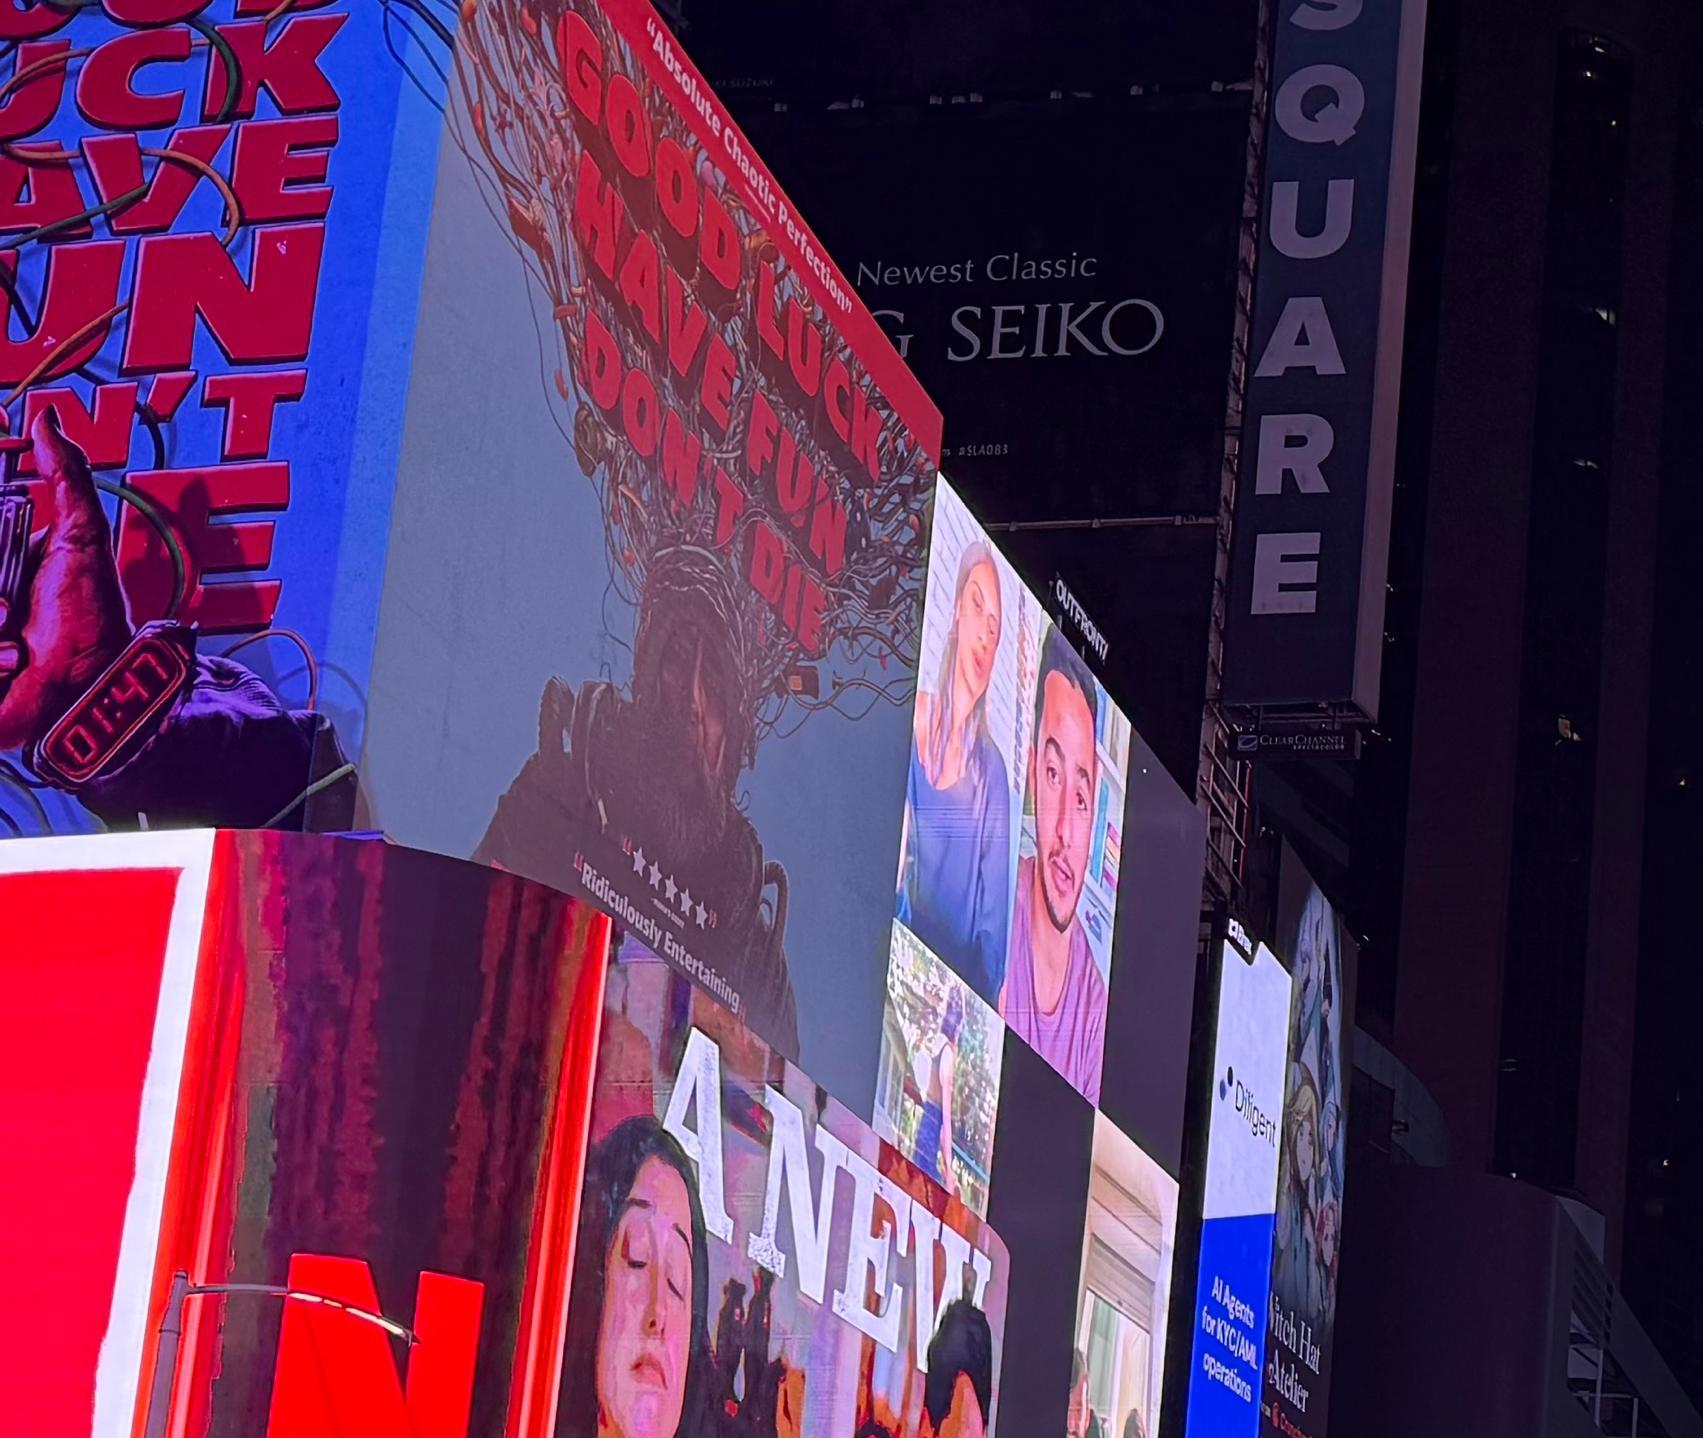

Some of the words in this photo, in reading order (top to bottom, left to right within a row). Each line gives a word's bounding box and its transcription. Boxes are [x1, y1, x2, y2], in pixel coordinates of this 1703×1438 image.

[723, 128, 776, 215] Chaotic
[557, 10, 741, 291] GOOD
[757, 261, 884, 483] LUCK
[856, 258, 974, 288] Newest
[986, 251, 1098, 283] Classic
[574, 150, 737, 432] HAVE
[747, 387, 848, 576] FUN
[946, 298, 1166, 363] SEIKO
[749, 519, 827, 653] DIE
[662, 1026, 735, 1246] A
[1235, 1081, 1276, 1149] Diligent
[1211, 1275, 1222, 1301] AI
[1223, 1281, 1255, 1330] Agents
[1202, 1309, 1217, 1338] for
[1217, 1318, 1258, 1370] KYC/AML
[1298, 1318, 1321, 1375] Hat
[1203, 1352, 1252, 1404] operations
